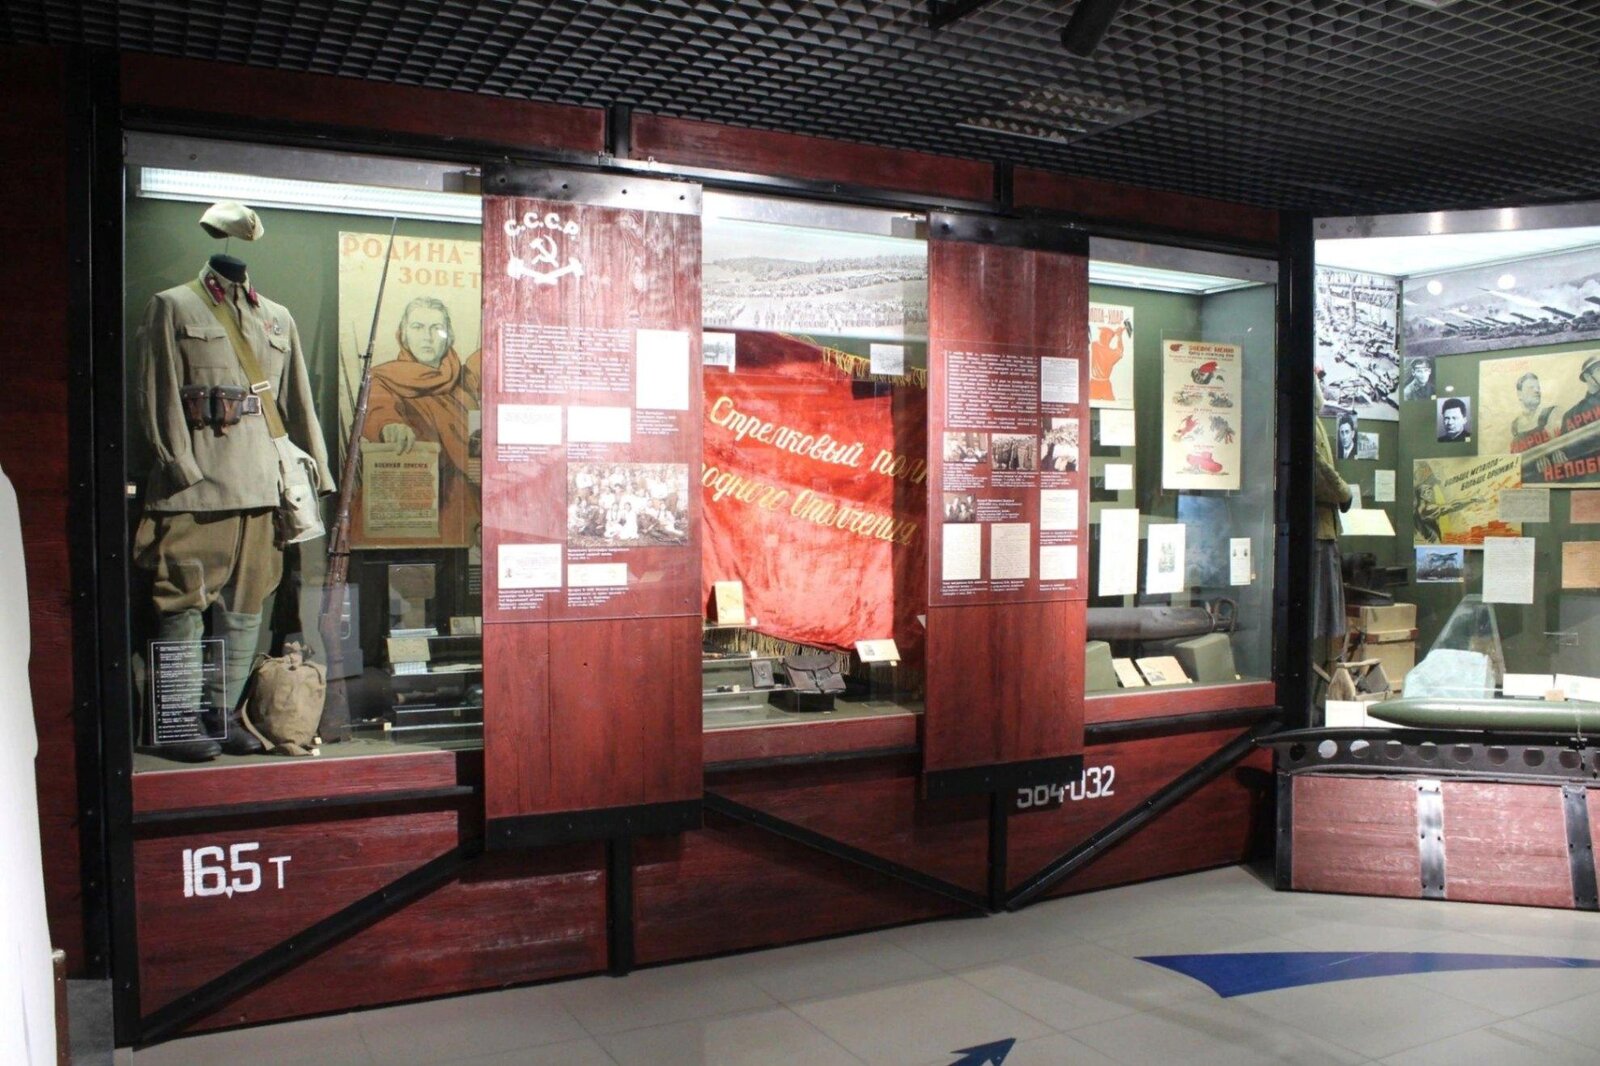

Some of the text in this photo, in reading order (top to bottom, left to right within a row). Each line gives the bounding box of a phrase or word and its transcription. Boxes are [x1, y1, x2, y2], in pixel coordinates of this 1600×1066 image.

[342, 234, 482, 265] РОДИНА-
[710, 396, 864, 468] Стрелковый
[702, 463, 789, 511] одного
[182, 842, 262, 899] 16,5
